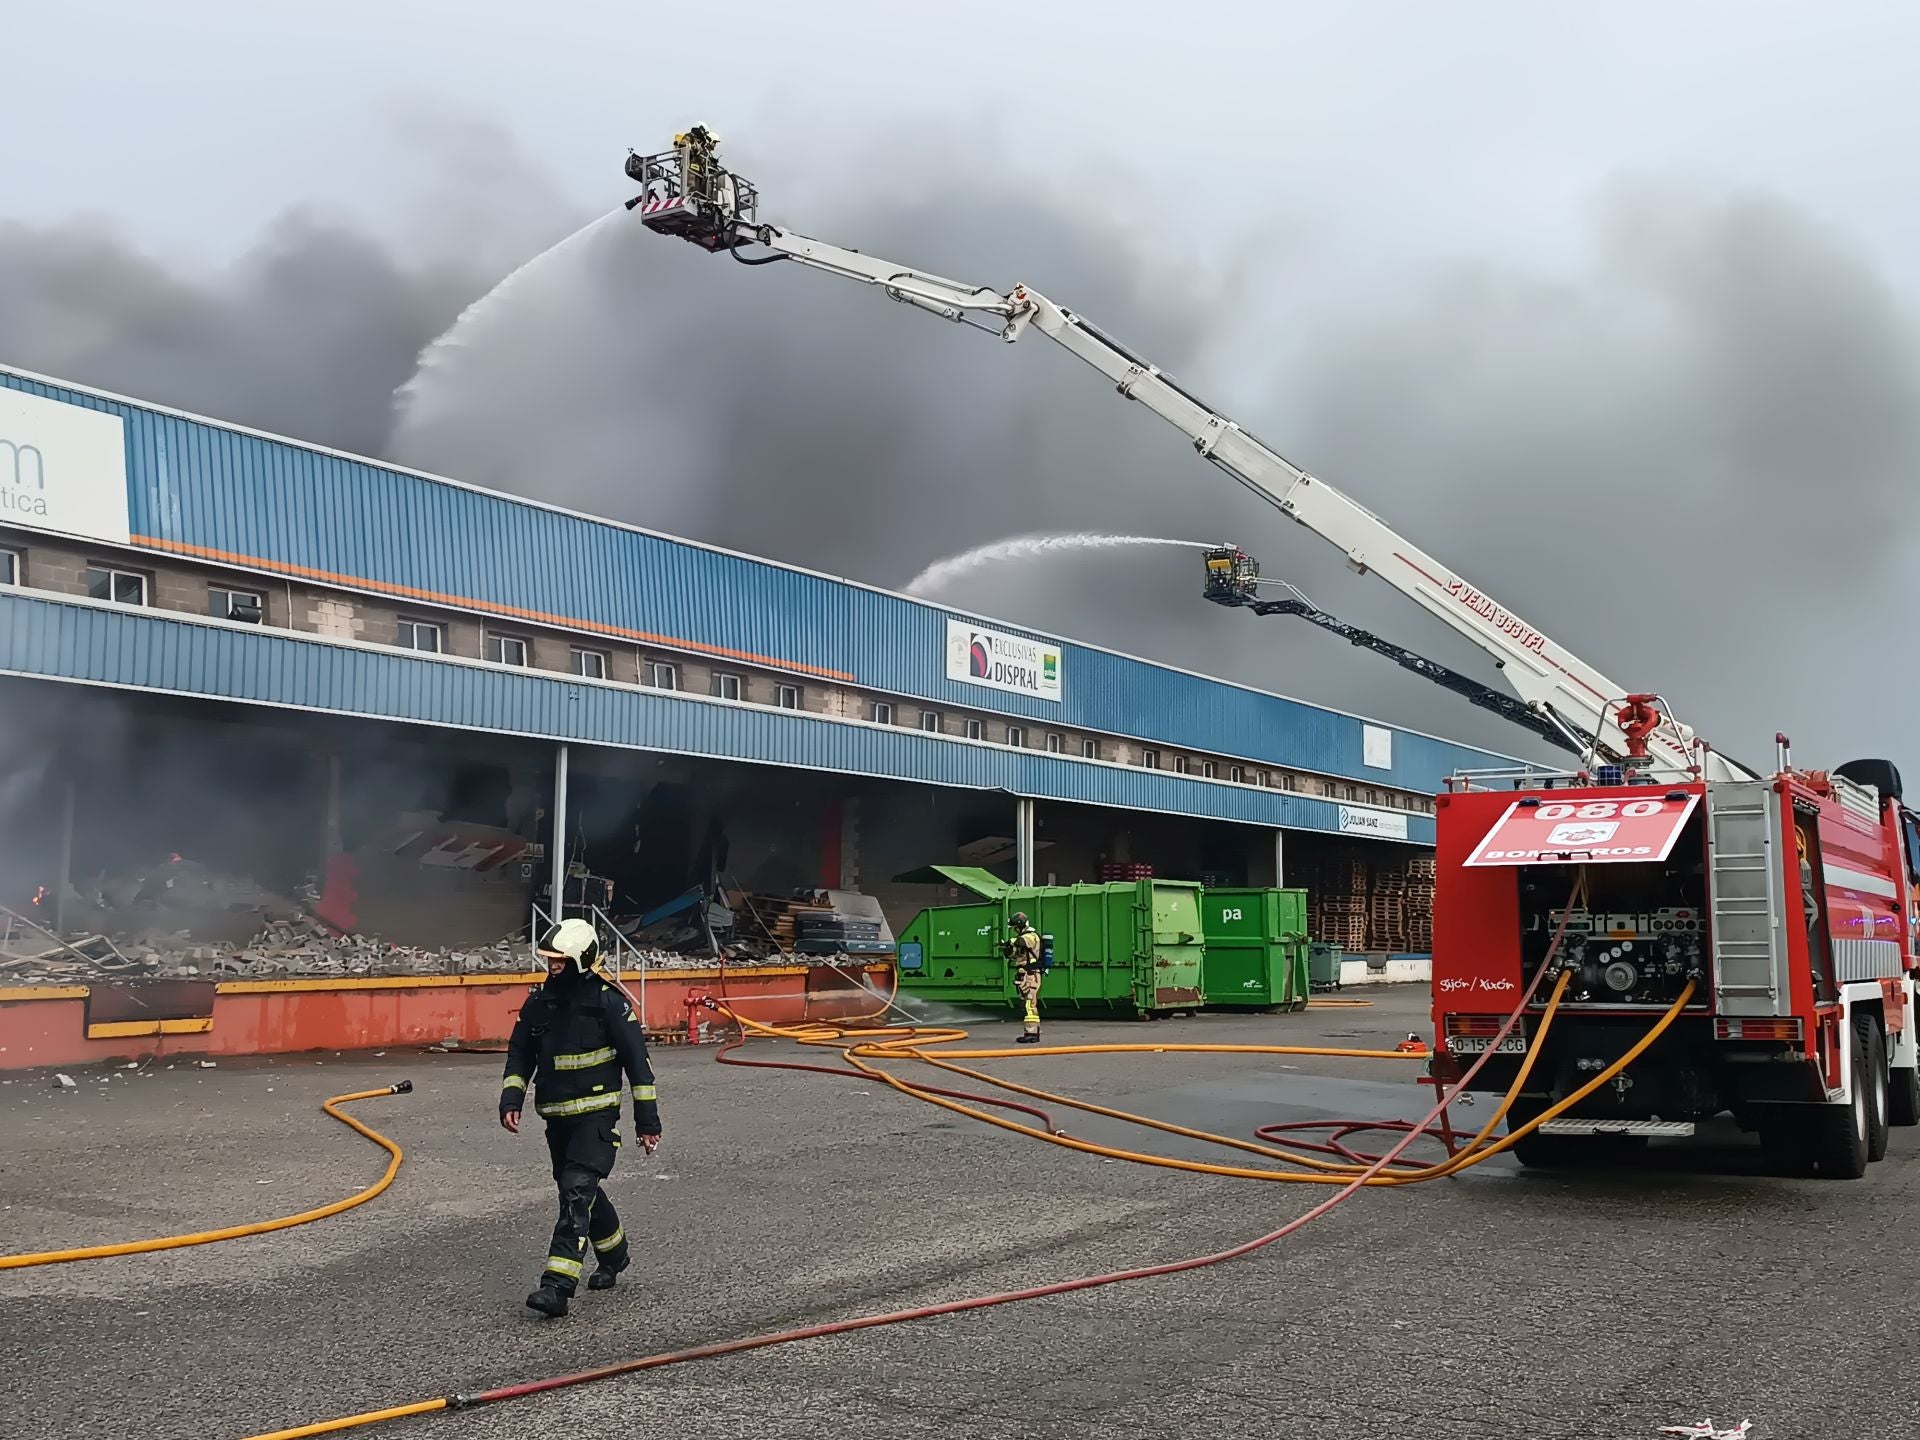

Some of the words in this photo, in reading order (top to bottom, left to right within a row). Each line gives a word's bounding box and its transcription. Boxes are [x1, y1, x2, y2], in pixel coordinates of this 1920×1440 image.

[1459, 584, 1498, 622] VEMA
[995, 638, 1036, 662] EXCLUSIVAS
[995, 662, 1038, 690] DISPRAL
[1534, 800, 1664, 820] 080
[1222, 908, 1242, 924] pa
